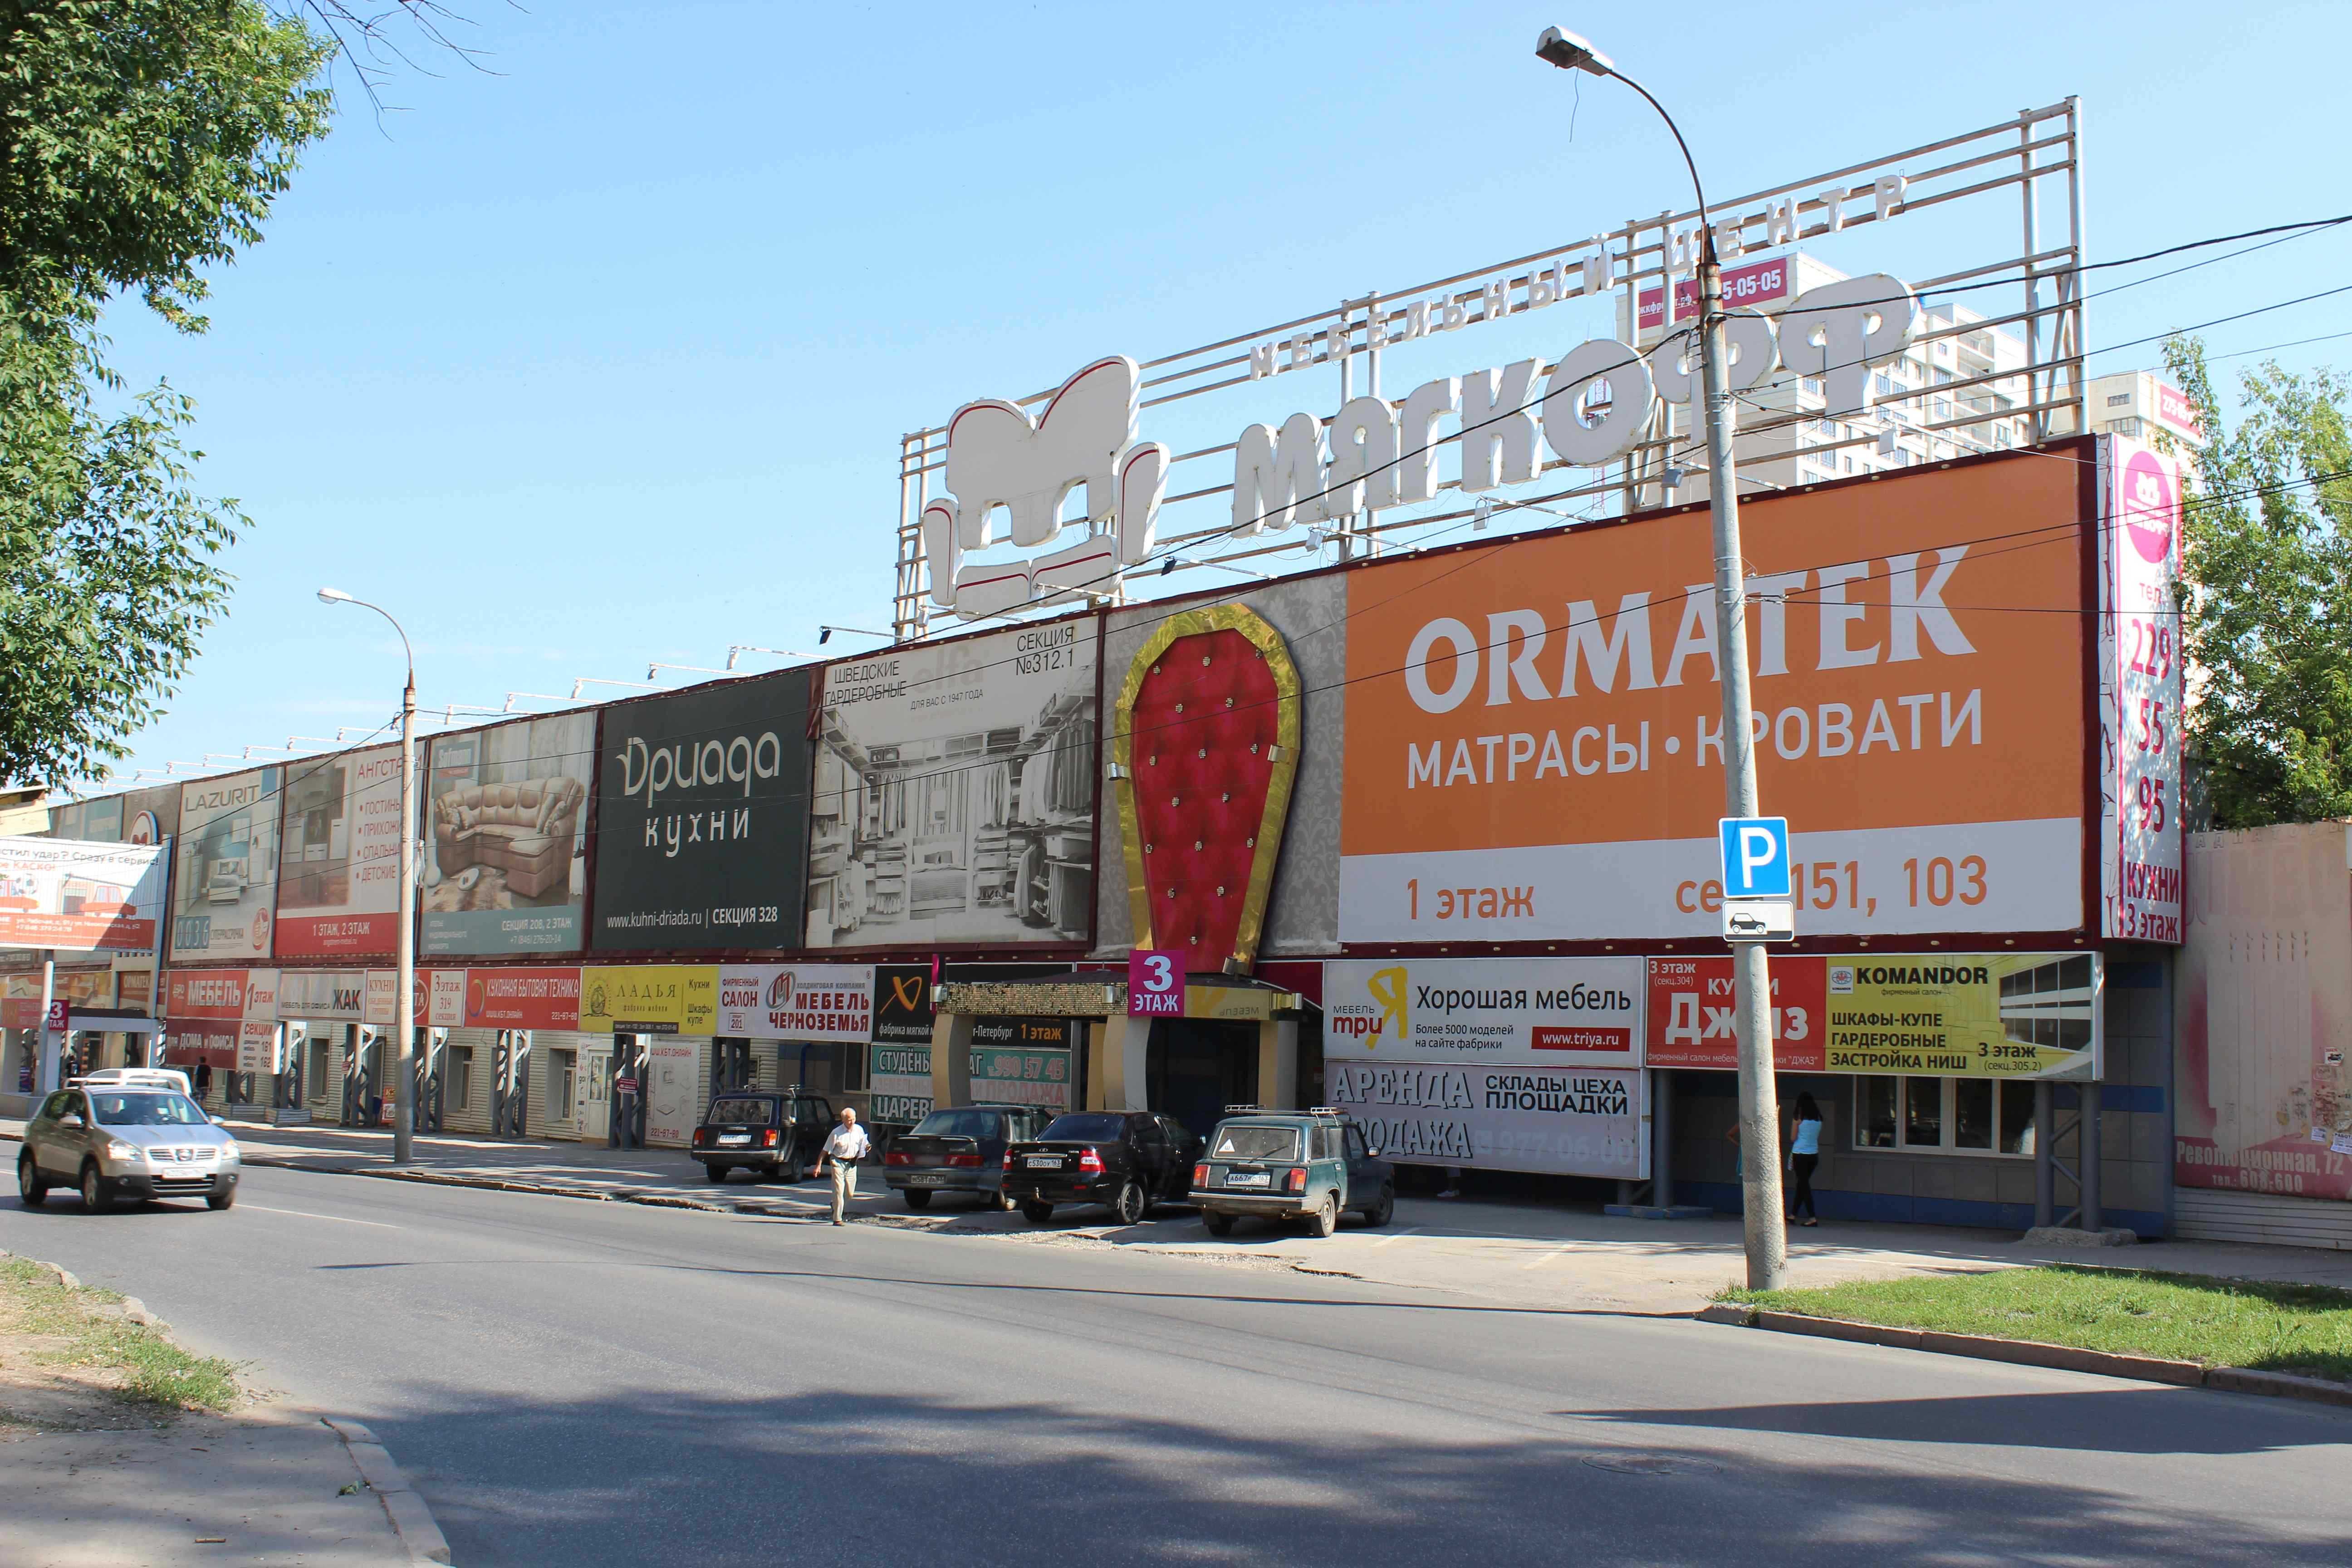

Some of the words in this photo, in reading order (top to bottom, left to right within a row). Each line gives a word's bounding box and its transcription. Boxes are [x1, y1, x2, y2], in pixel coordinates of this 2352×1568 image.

[1250, 232, 1614, 381] МЕБЕЛЬНЫЙ
[1665, 175, 1907, 278] ЦЕНТР
[1406, 545, 1977, 714] ORMATEK
[1017, 627, 1073, 652] СЕКЦИЯ
[2132, 618, 2171, 679] 229
[1016, 648, 1073, 675] №312.1
[834, 661, 900, 684] ШВЕДСКИЕ
[825, 681, 906, 707] ГАРДЕРОБНЫЕ
[911, 701, 924, 710] ДЛЯ
[926, 697, 939, 707] ВАС
[941, 696, 946, 705] С
[949, 692, 963, 703] 1947
[965, 689, 983, 700] ГОДА
[2139, 698, 2164, 755] 55
[1407, 720, 1648, 789] МАТРАСЫ
[1696, 688, 1982, 767] КРОВАТИ
[185, 784, 260, 812] LAZURIT
[2141, 776, 2164, 832] 95
[73, 852, 106, 864] Сразу
[1740, 827, 1776, 888] P
[362, 865, 396, 883] ДЕТСКИЕ
[2127, 862, 2179, 904] КУХНИ
[1790, 860, 1877, 917] 151,
[1903, 855, 1987, 907] 103
[1407, 879, 1418, 920] 1
[1436, 886, 1534, 918] этаж
[501, 920, 528, 932] СЕКЦИЯ
[546, 919, 550, 929] 2
[552, 918, 573, 929] ЭТАЖ
[607, 909, 702, 928] www.kuhni-driada.ru
[713, 907, 756, 927] СЕКЦИЯ
[759, 906, 778, 922] 328
[2127, 903, 2136, 937] 3
[2140, 911, 2178, 941] этаж
[313, 924, 317, 936] 1
[318, 924, 340, 937] ЭТАЖ,
[342, 923, 346, 935] 2
[348, 922, 370, 935] ЭТАЖ
[1143, 955, 1173, 992] 3
[1649, 961, 1658, 974] 3
[1661, 961, 1695, 974] этаж
[1856, 967, 1988, 985] KOMANDOR
[369, 980, 395, 992] КУХНИ
[435, 975, 440, 991] 3
[441, 981, 461, 992] этаж
[487, 979, 517, 997] КУХОННАЯ
[518, 979, 547, 998] БЫТОВАЯ
[549, 979, 578, 998] ТЕХНИКА
[689, 979, 710, 991] Кухни
[722, 976, 759, 987] ФИРМЕННЫЙ
[1654, 976, 1694, 987] (секц.304)
[1708, 978, 1779, 995] КУИ
[187, 980, 241, 1007] МЕБЕЛЬ
[247, 983, 255, 1010] 1
[255, 990, 275, 1003] этаж
[333, 989, 361, 1010] ЖАК
[617, 984, 676, 1002] ЛАДЬЯ
[722, 990, 758, 1007] САЛОН
[796, 993, 869, 1011] МЕБЕЛЬ
[1416, 985, 1527, 1015] Хорошая
[1535, 983, 1631, 1010] мебель
[49, 1002, 63, 1019] 3
[439, 997, 451, 1010] 319
[688, 1003, 712, 1016] Шкафы
[1134, 994, 1179, 1012] ЭТАЖ
[1333, 1005, 1375, 1014] МЕБЕЛЬ
[49, 1020, 64, 1028] ТАЖ
[436, 1012, 456, 1020] секция
[687, 1016, 703, 1026] купе
[731, 1019, 743, 1029] 201
[769, 1012, 869, 1032] ЧЕРНОЗЕМЬЯ
[1665, 992, 1809, 1045] Джз
[1832, 1013, 1942, 1027] ШКАФЫ-КУПЕ
[244, 1023, 273, 1038] секции
[879, 1023, 905, 1037] фабрика
[906, 1024, 930, 1035] мягкой
[1021, 1024, 1027, 1039] 1
[1030, 1027, 1062, 1040] этаж
[1416, 1024, 1443, 1035] Более
[1445, 1024, 1468, 1035] 5000
[1470, 1024, 1514, 1036] моделей
[1542, 1032, 1619, 1046] www.triya.ru
[180, 1033, 202, 1050] ДОМА
[209, 1034, 235, 1051] ОФИСА
[1416, 1039, 1426, 1048] на
[1429, 1038, 1455, 1049] сайте
[1456, 1038, 1502, 1052] фабрики
[1831, 1033, 1946, 1049] ГАРДЕРОБНЫЕ
[1647, 1052, 1688, 1063] фирменный
[1831, 1050, 1922, 1068] ЗАСТРОЙКА
[1927, 1055, 1967, 1069] НИШ
[1978, 1043, 1987, 1057] 3
[1993, 1045, 2036, 1058] этаж
[994, 1055, 1021, 1078] 990
[1024, 1057, 1043, 1079] 57
[1045, 1058, 1065, 1080] 45
[1788, 1056, 1818, 1065] "ДЖАЗ"
[1984, 1059, 2042, 1073] (секц.305.2)
[1332, 1067, 1474, 1109] АРЕНДА
[1485, 1074, 1567, 1093] СКЛАДЫ
[1573, 1078, 1627, 1095] ЦЕХА
[1485, 1091, 1628, 1115] ПЛОЩАДКИ
[1353, 1116, 1474, 1159] РОДАЖА
[2177, 1141, 2321, 1176] Революционная,
[2323, 1151, 2344, 1175] 72
